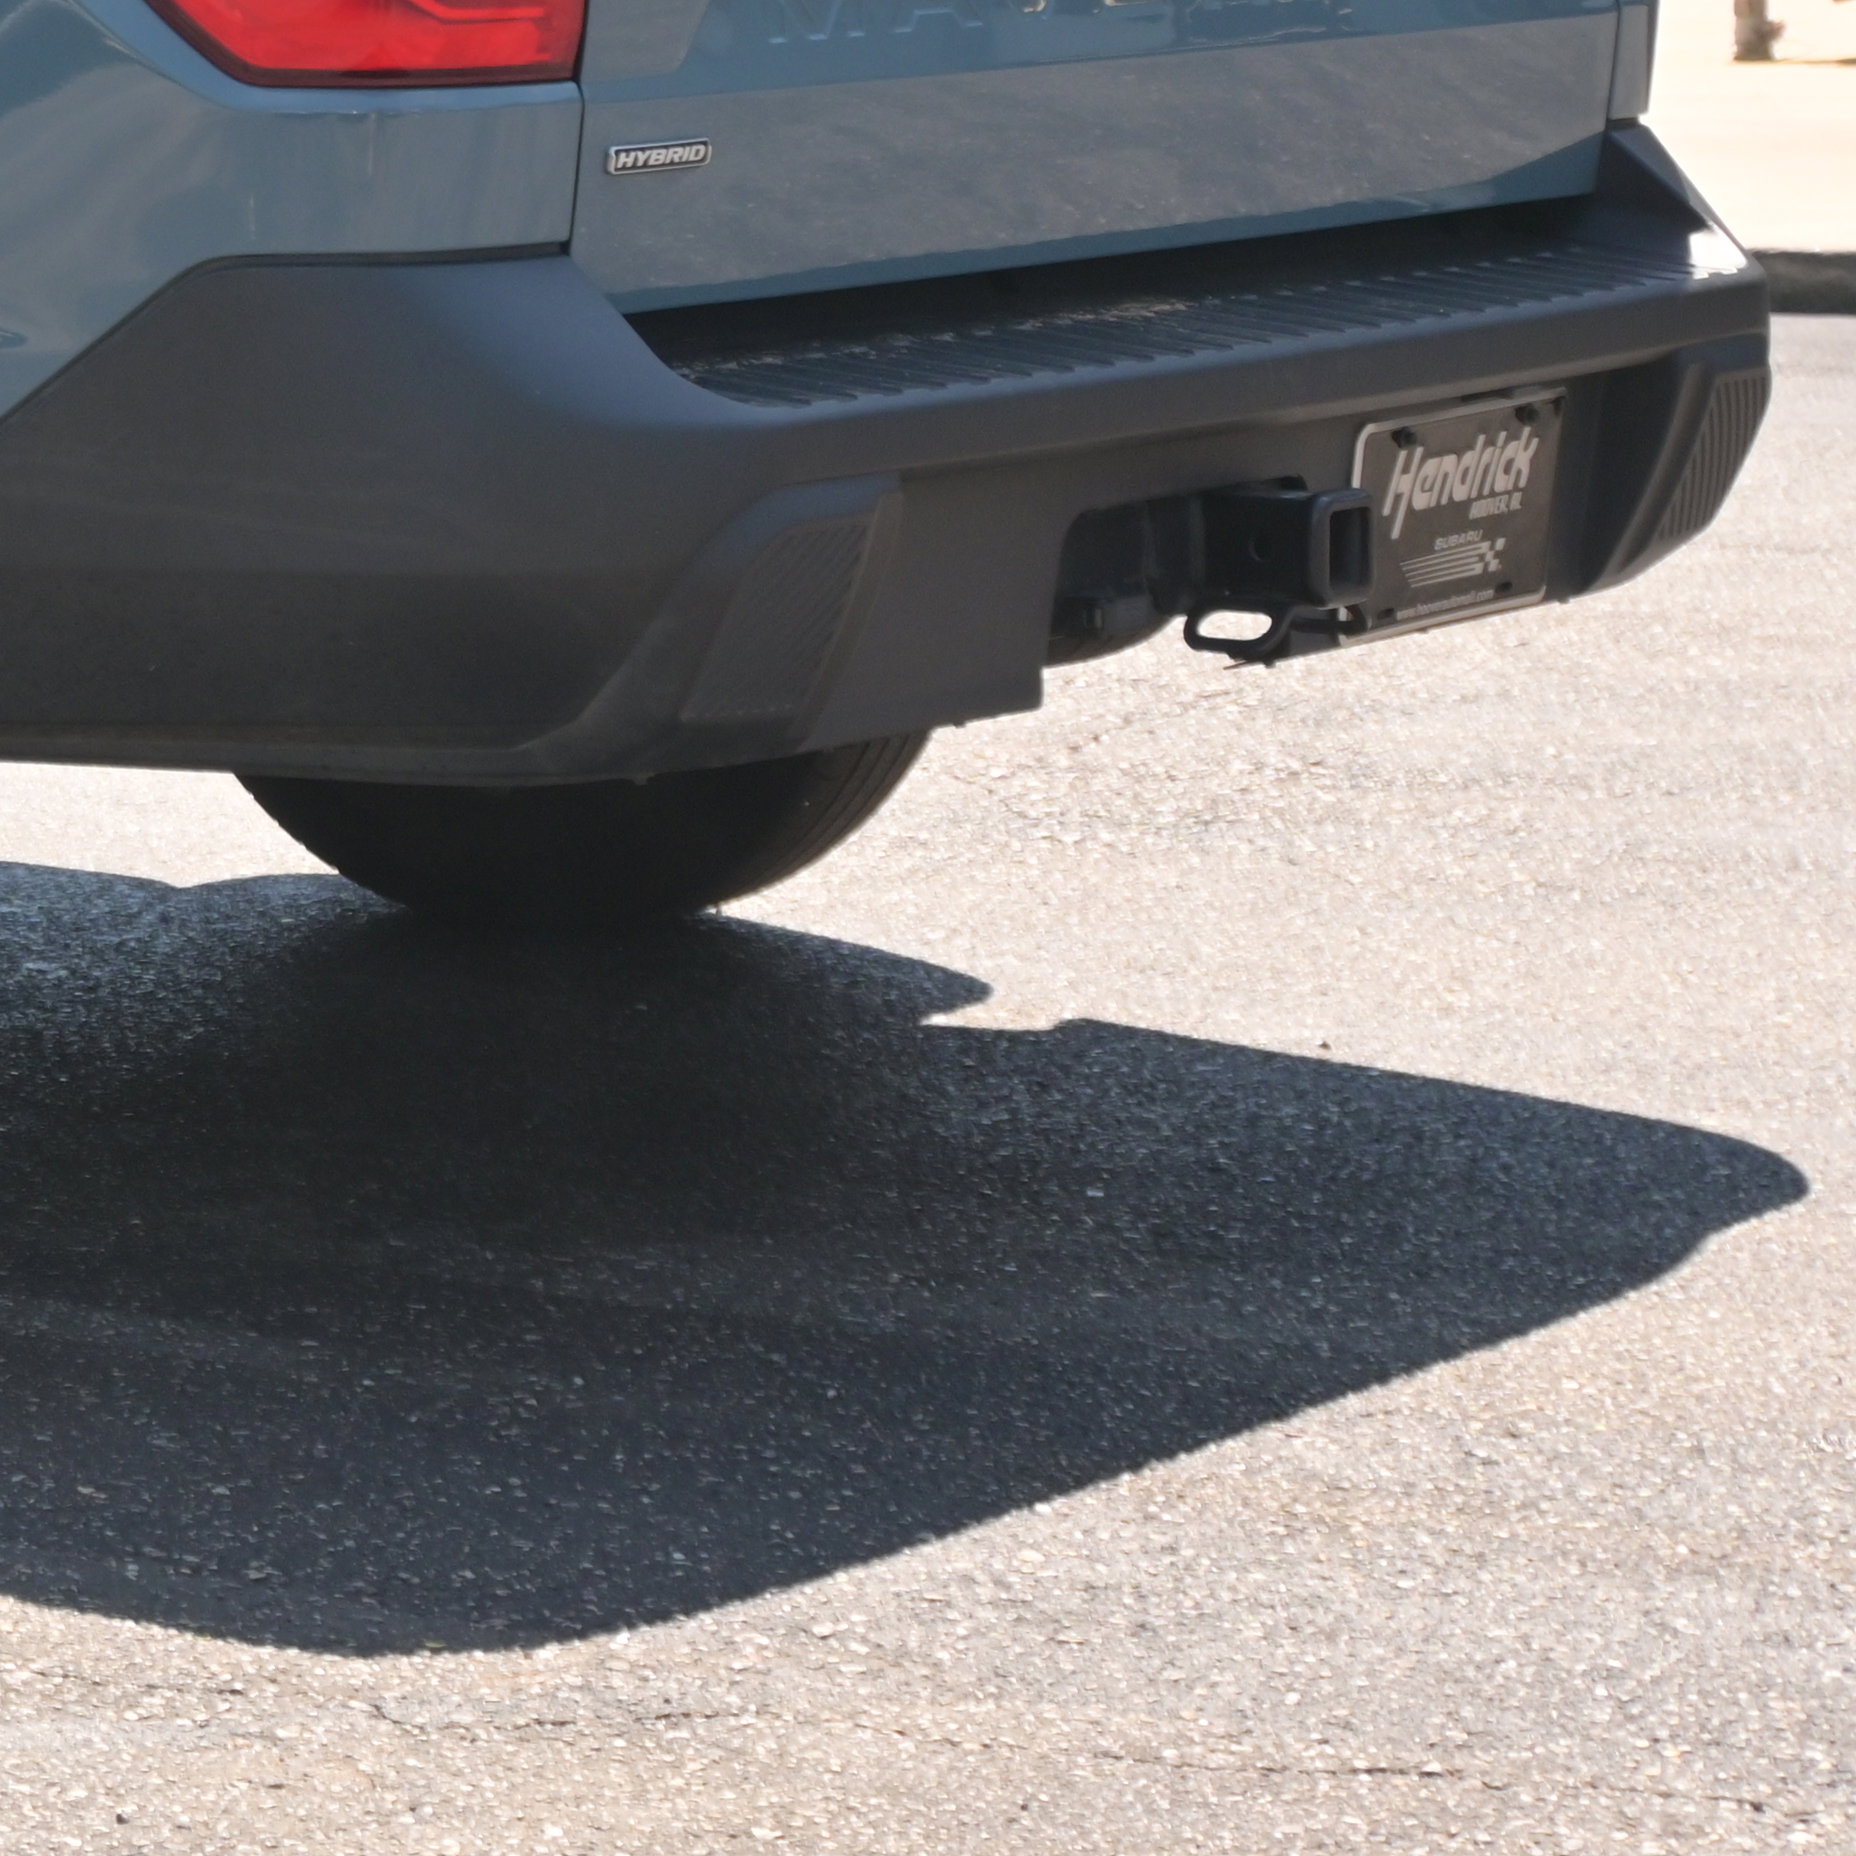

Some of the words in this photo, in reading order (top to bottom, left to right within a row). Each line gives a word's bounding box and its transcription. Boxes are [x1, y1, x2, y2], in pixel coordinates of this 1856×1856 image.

[615, 144, 707, 169] HYBRID
[1382, 426, 1540, 540] Hendrick
[1434, 529, 1483, 551] SUBARU
